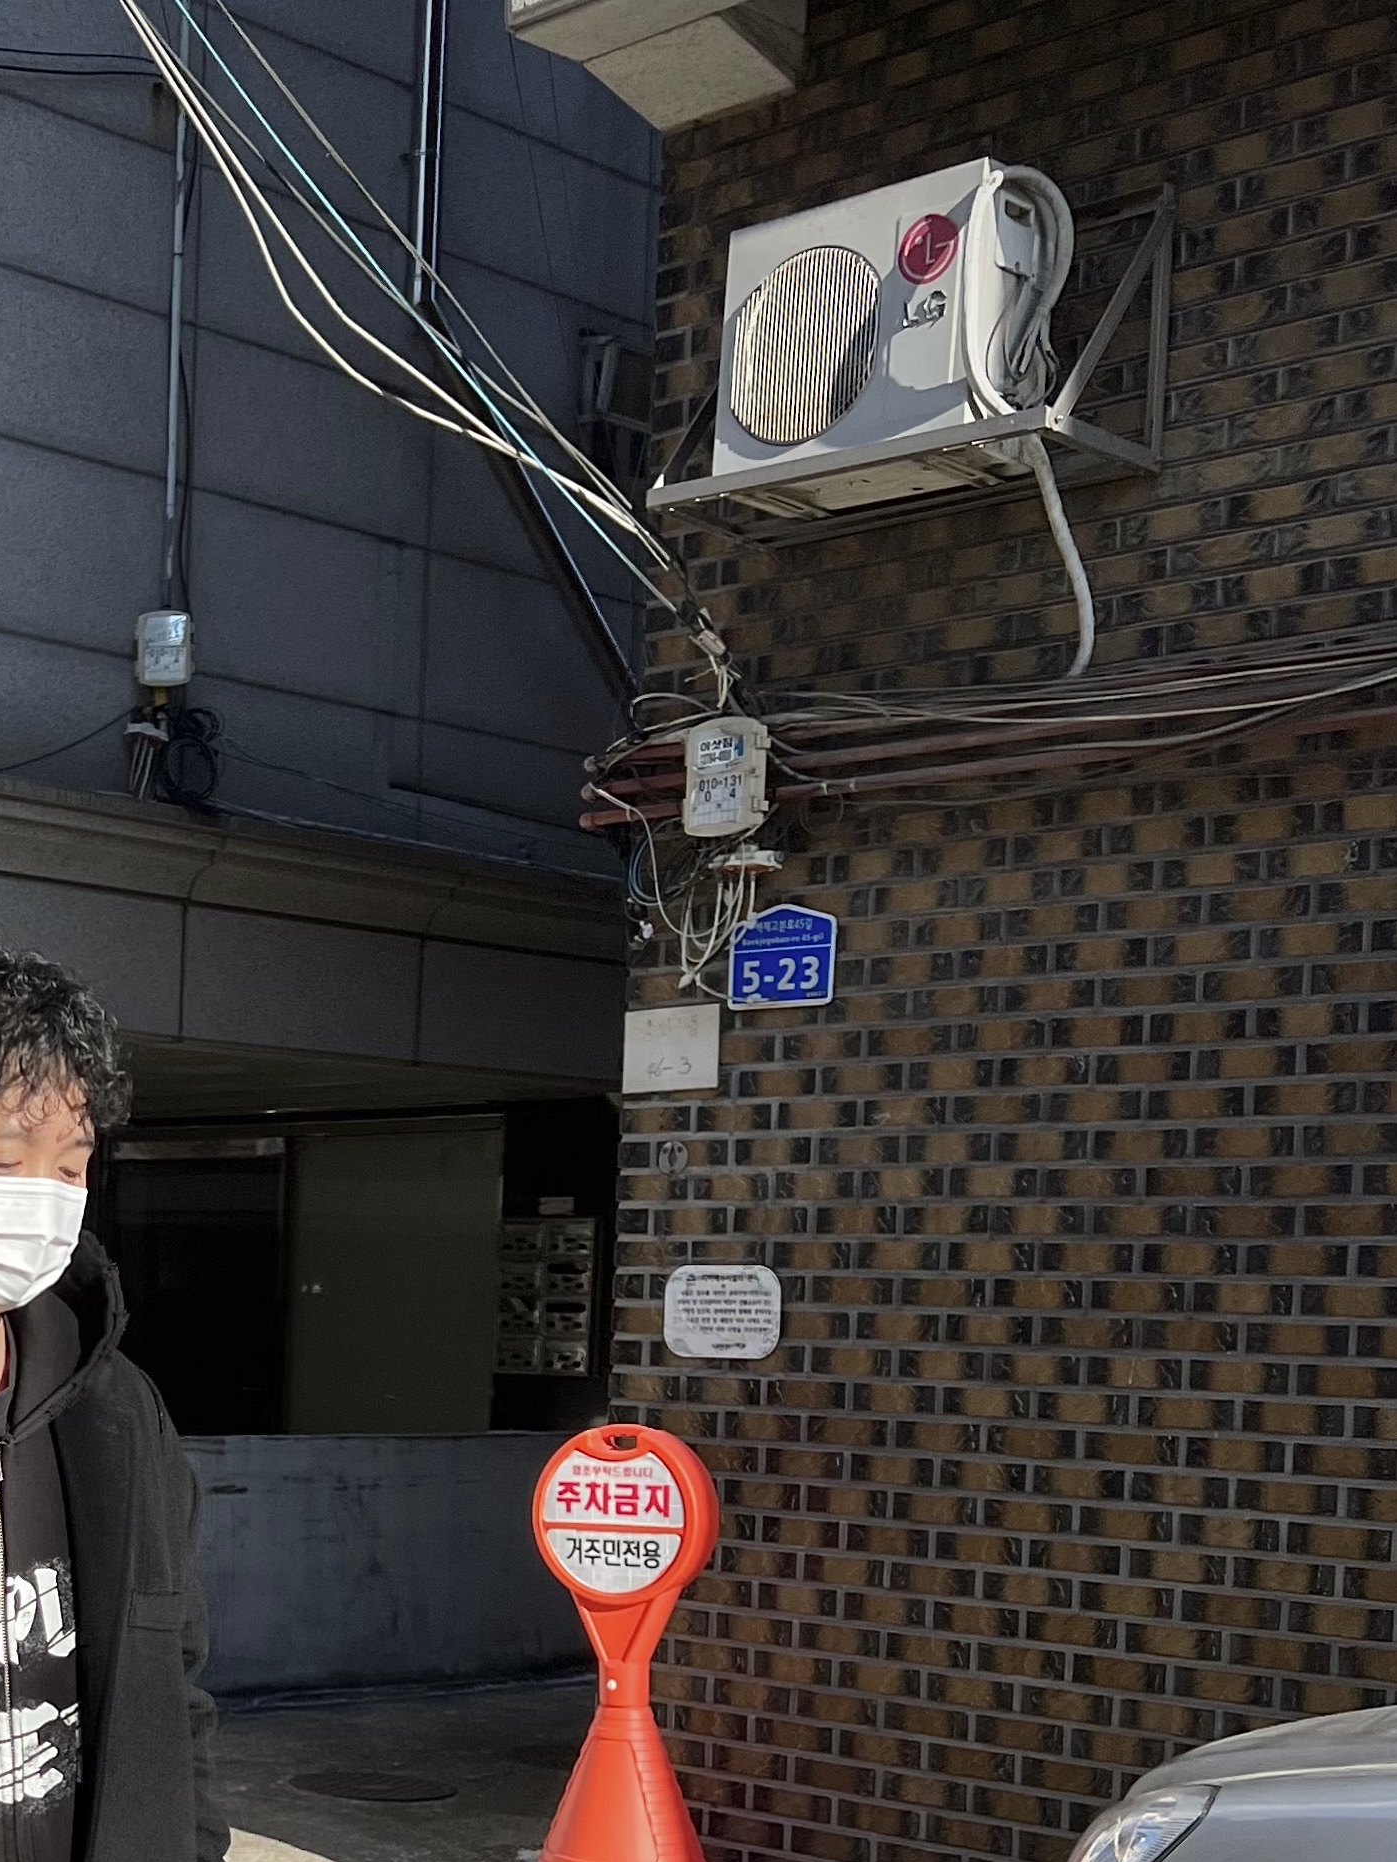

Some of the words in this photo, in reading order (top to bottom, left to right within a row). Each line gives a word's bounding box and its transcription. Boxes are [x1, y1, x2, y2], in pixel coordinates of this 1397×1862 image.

[902, 290, 947, 328] LG
[742, 956, 820, 994] 5-23
[556, 1481, 670, 1518] 주차금지
[566, 1537, 661, 1569] 거주민전용
